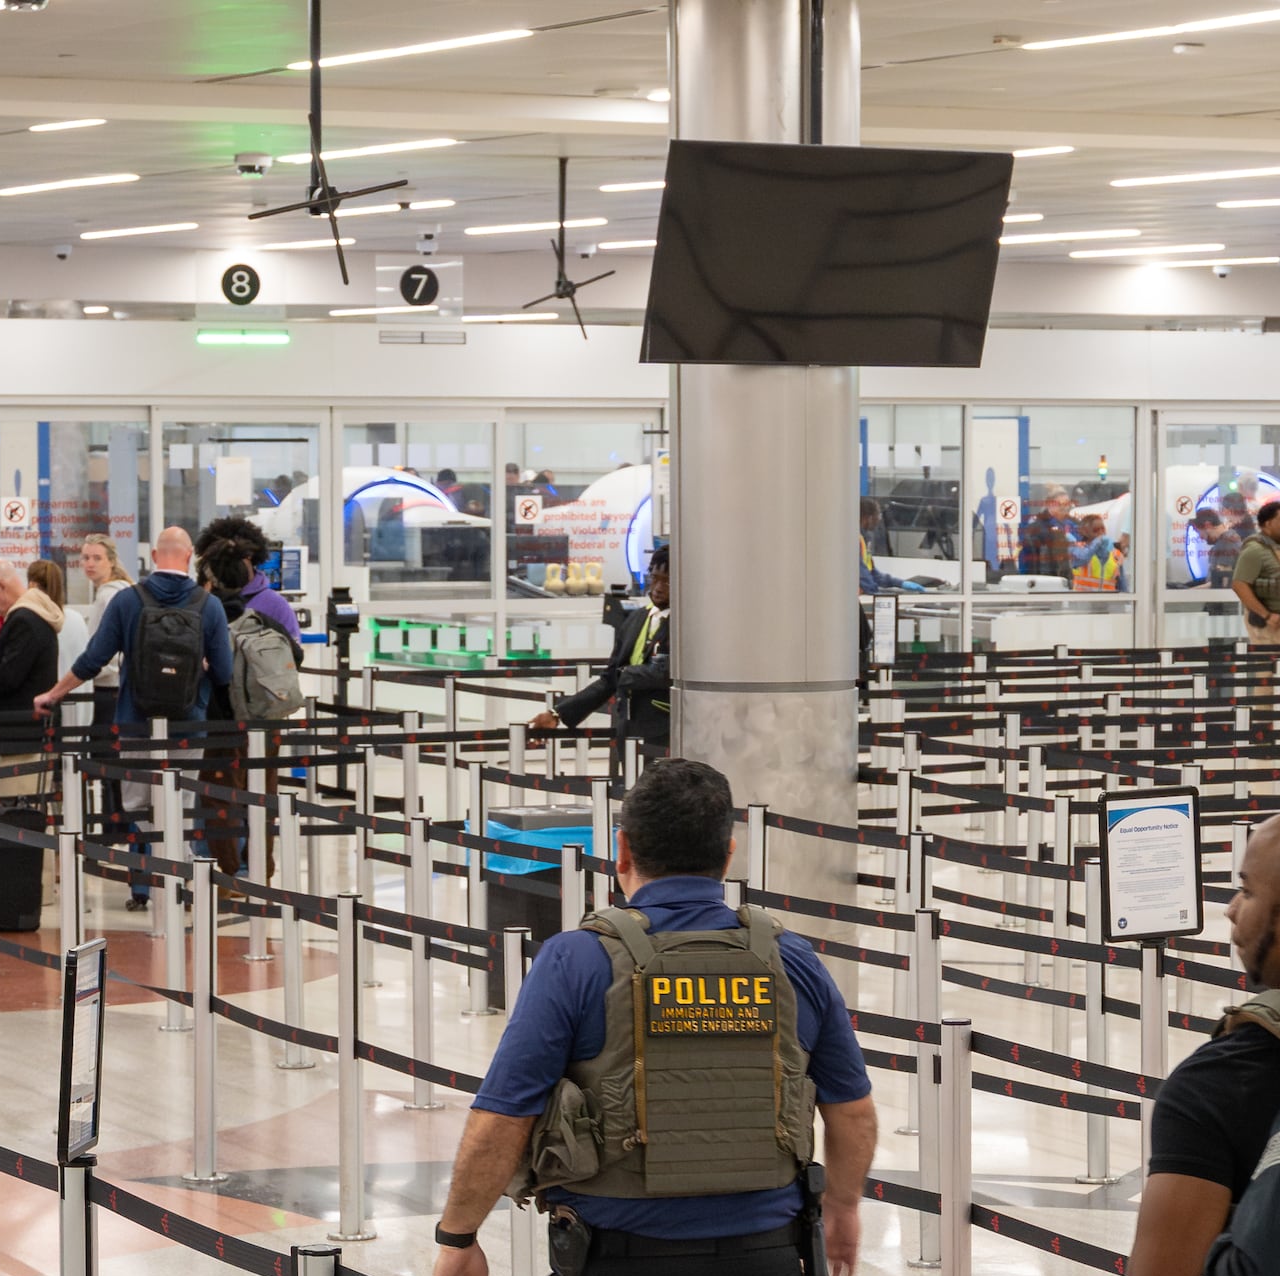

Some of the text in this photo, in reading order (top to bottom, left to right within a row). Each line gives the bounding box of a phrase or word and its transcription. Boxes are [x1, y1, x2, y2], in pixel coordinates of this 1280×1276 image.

[231, 270, 251, 298] 8
[411, 274, 428, 300] 7
[590, 499, 607, 507] are
[543, 512, 597, 523] prohibited
[0, 529, 21, 539] this
[114, 529, 133, 538] are
[571, 526, 617, 536] Violators
[569, 540, 606, 550] federal
[609, 541, 620, 550] or
[1133, 824, 1162, 833] Opportunity
[651, 976, 772, 1005] POLICE
[660, 1006, 760, 1019] IMMIGRATION AND
[650, 1019, 774, 1033] CUSTOMS ENFORCEMENT
